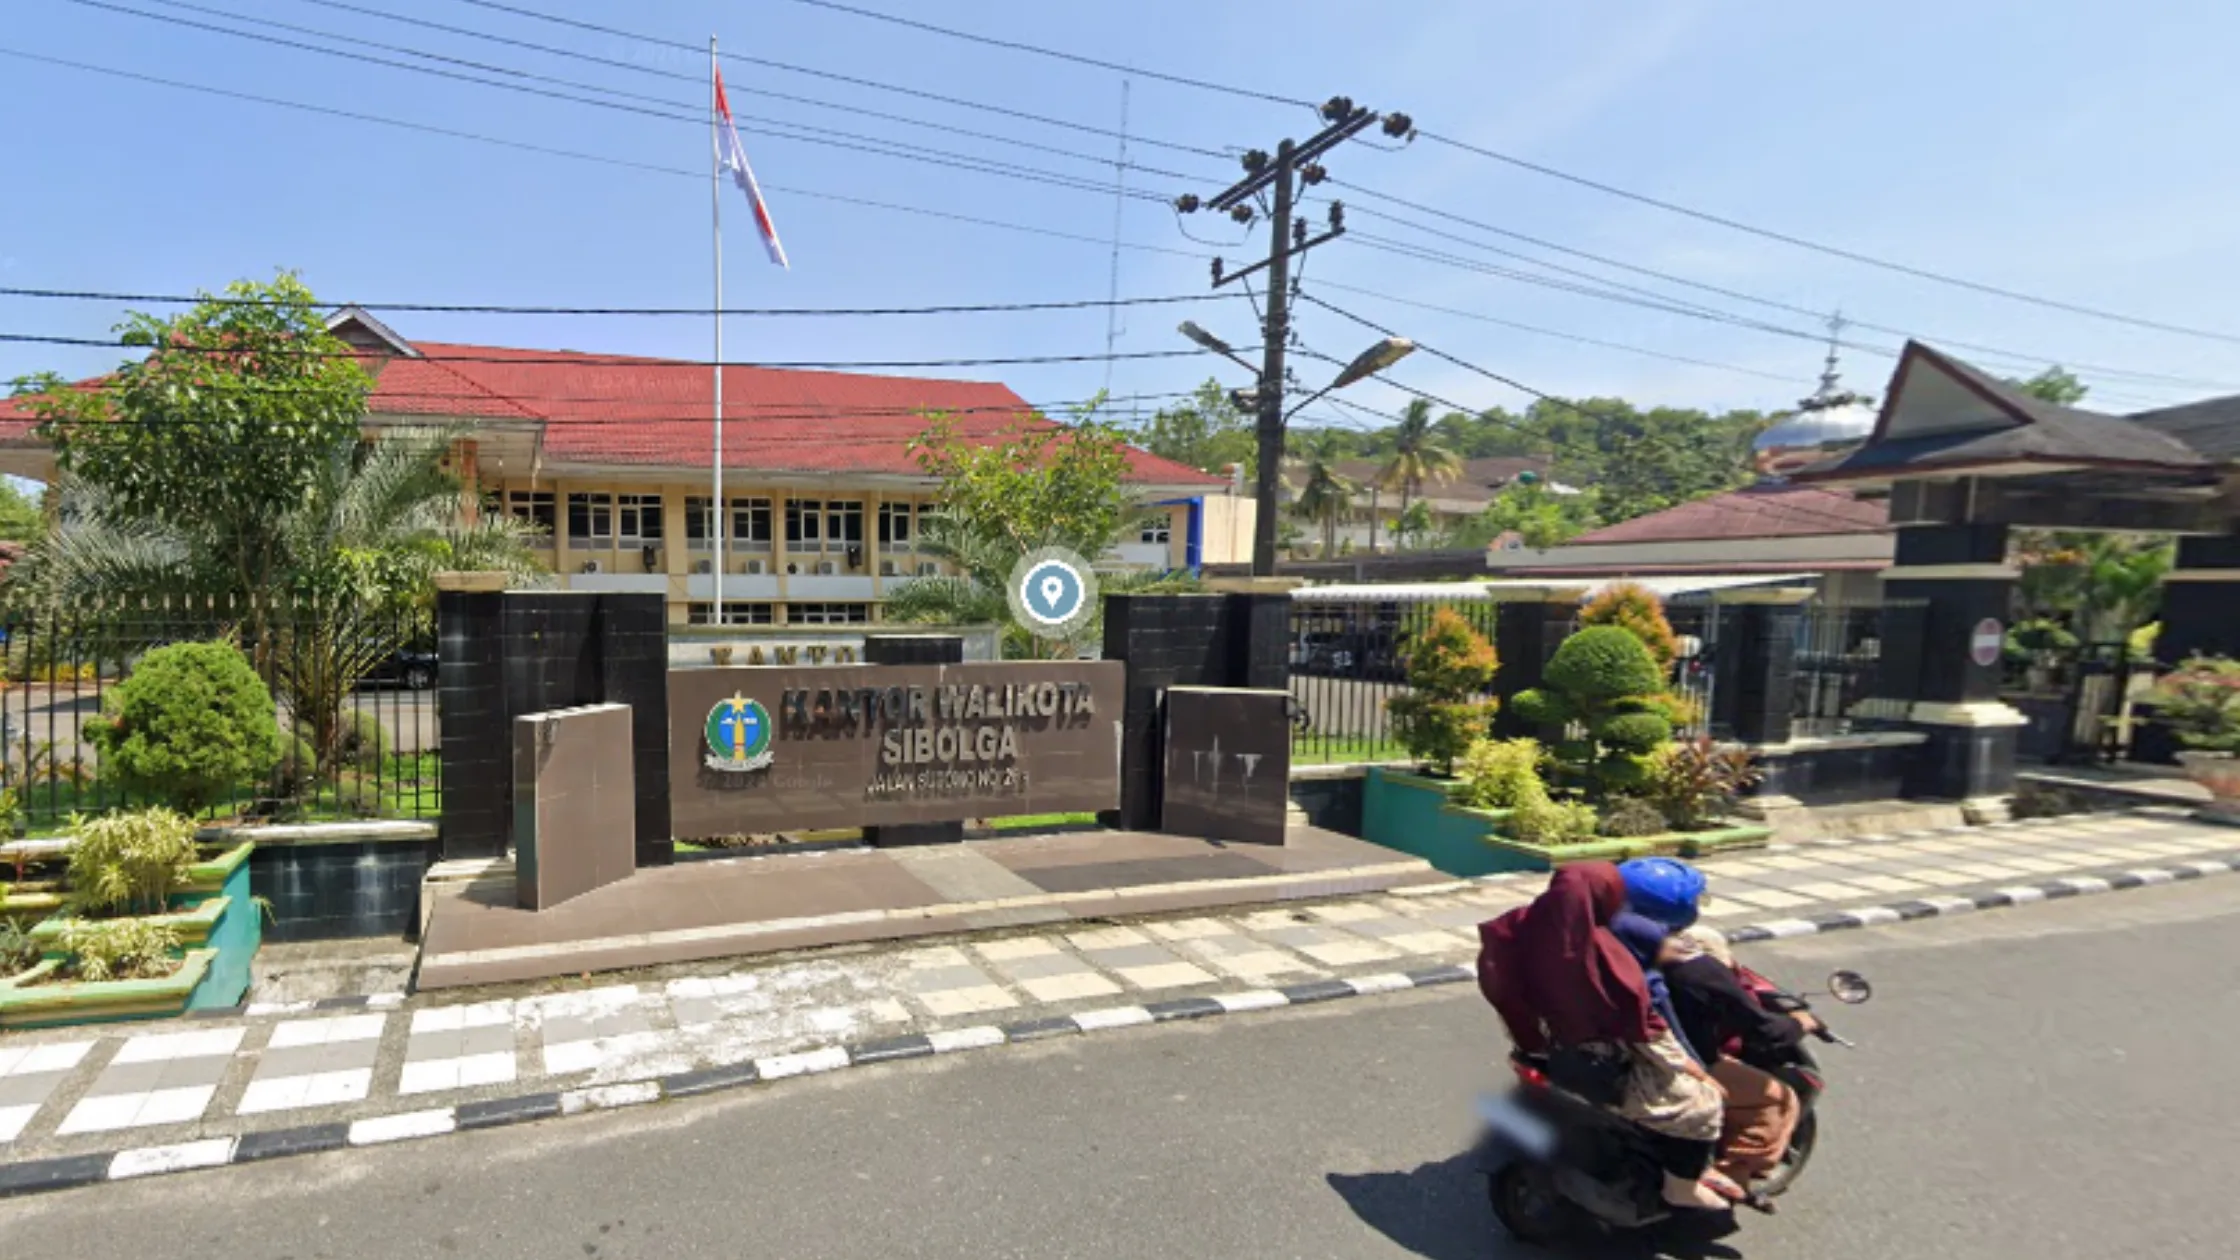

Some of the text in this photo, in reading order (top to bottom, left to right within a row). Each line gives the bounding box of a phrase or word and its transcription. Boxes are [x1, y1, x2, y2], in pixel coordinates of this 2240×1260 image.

[711, 644, 857, 665] KANTO
[782, 681, 1097, 724] KANTOR WALIKOTA
[882, 724, 1019, 765] SIBOLGA
[866, 771, 914, 792] JALAN
